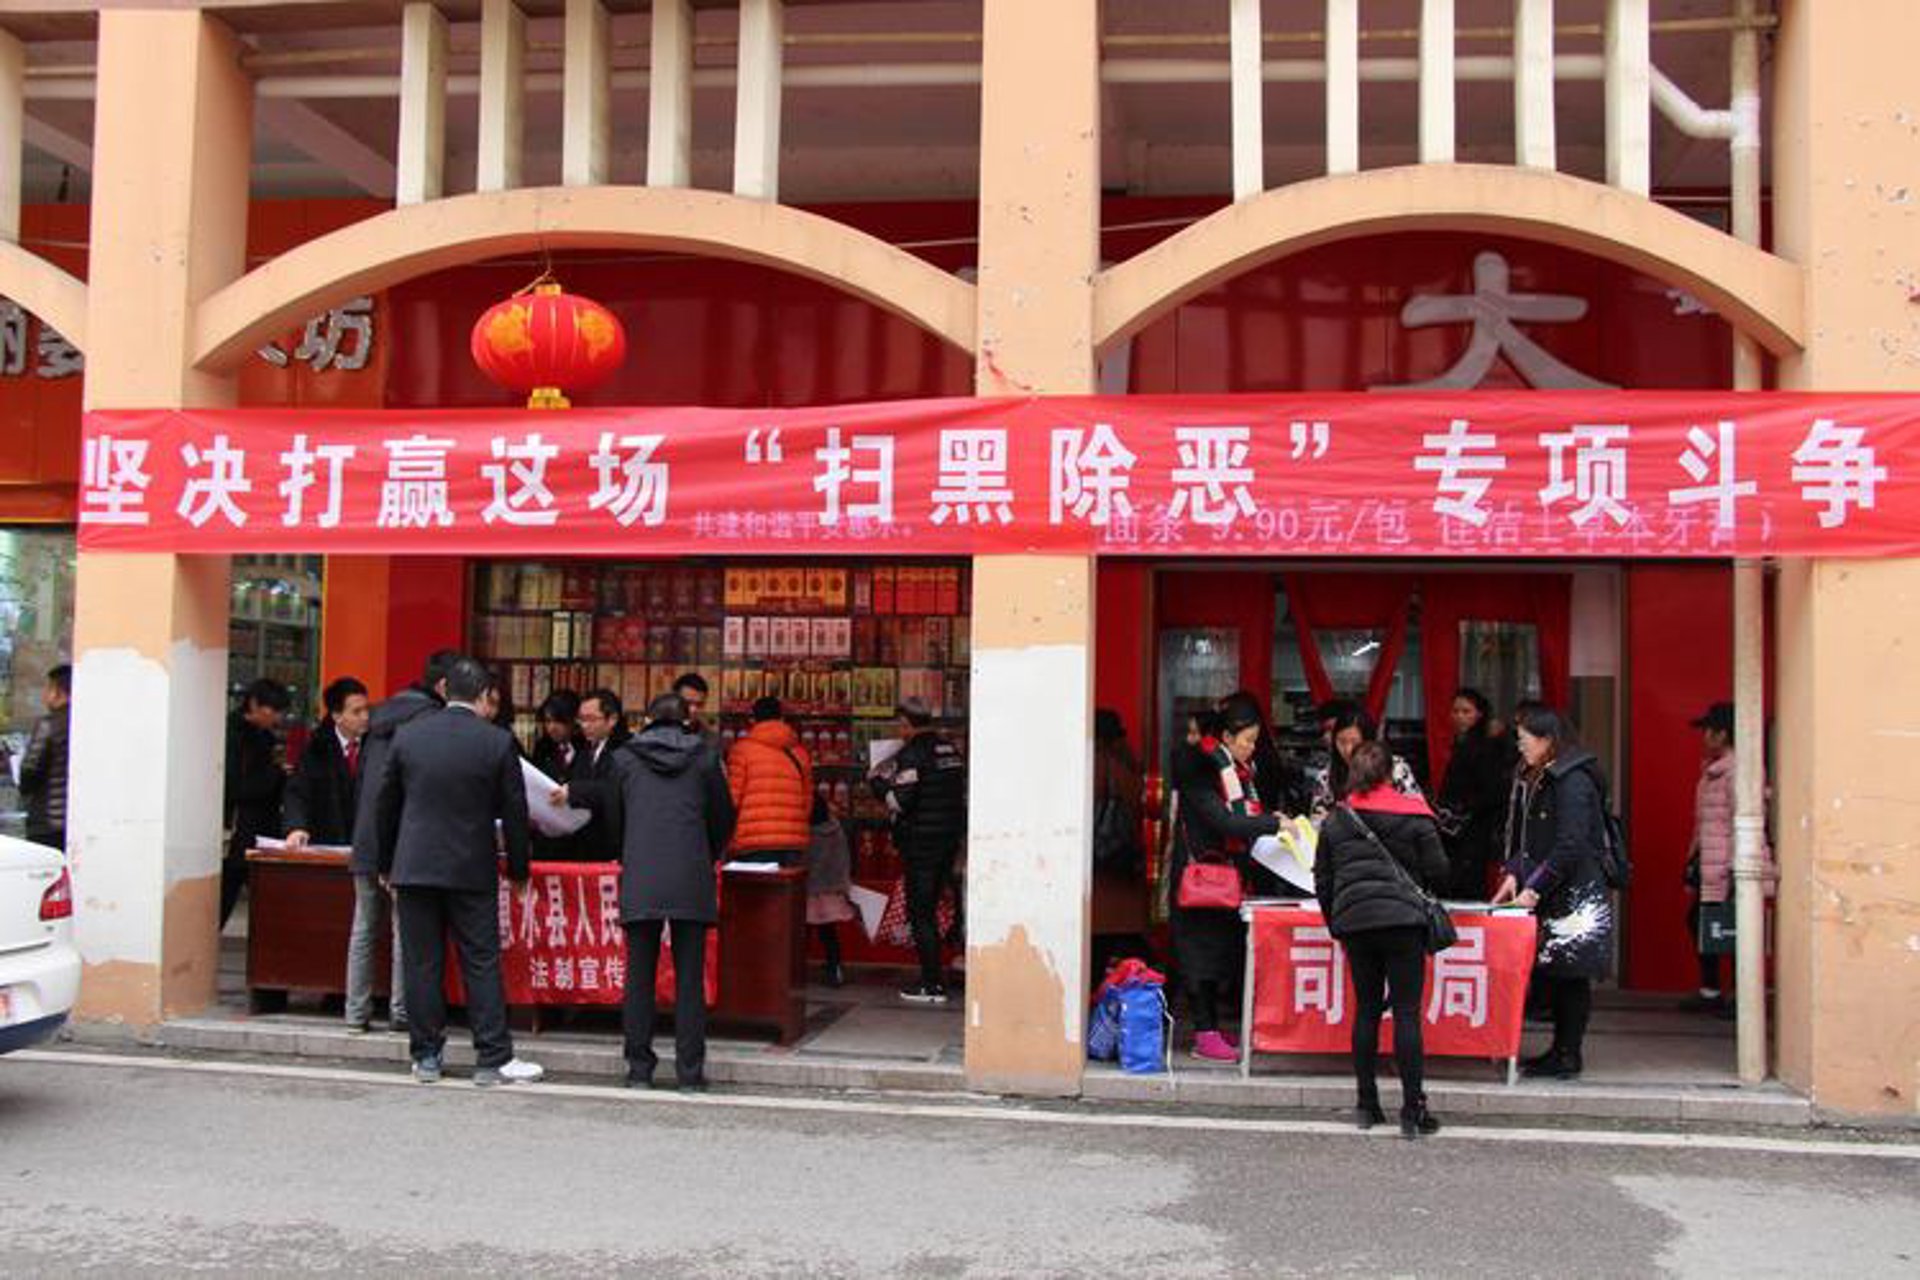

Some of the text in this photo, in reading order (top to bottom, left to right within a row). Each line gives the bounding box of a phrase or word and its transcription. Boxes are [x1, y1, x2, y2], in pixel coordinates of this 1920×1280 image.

[257, 296, 373, 373] 坊
[1380, 251, 1614, 391] 大
[80, 418, 1888, 530] 坚决打赢这场“扫黑除恶”专项斗争
[529, 955, 628, 990] 法制宣传
[1289, 926, 1488, 1029] 司局
